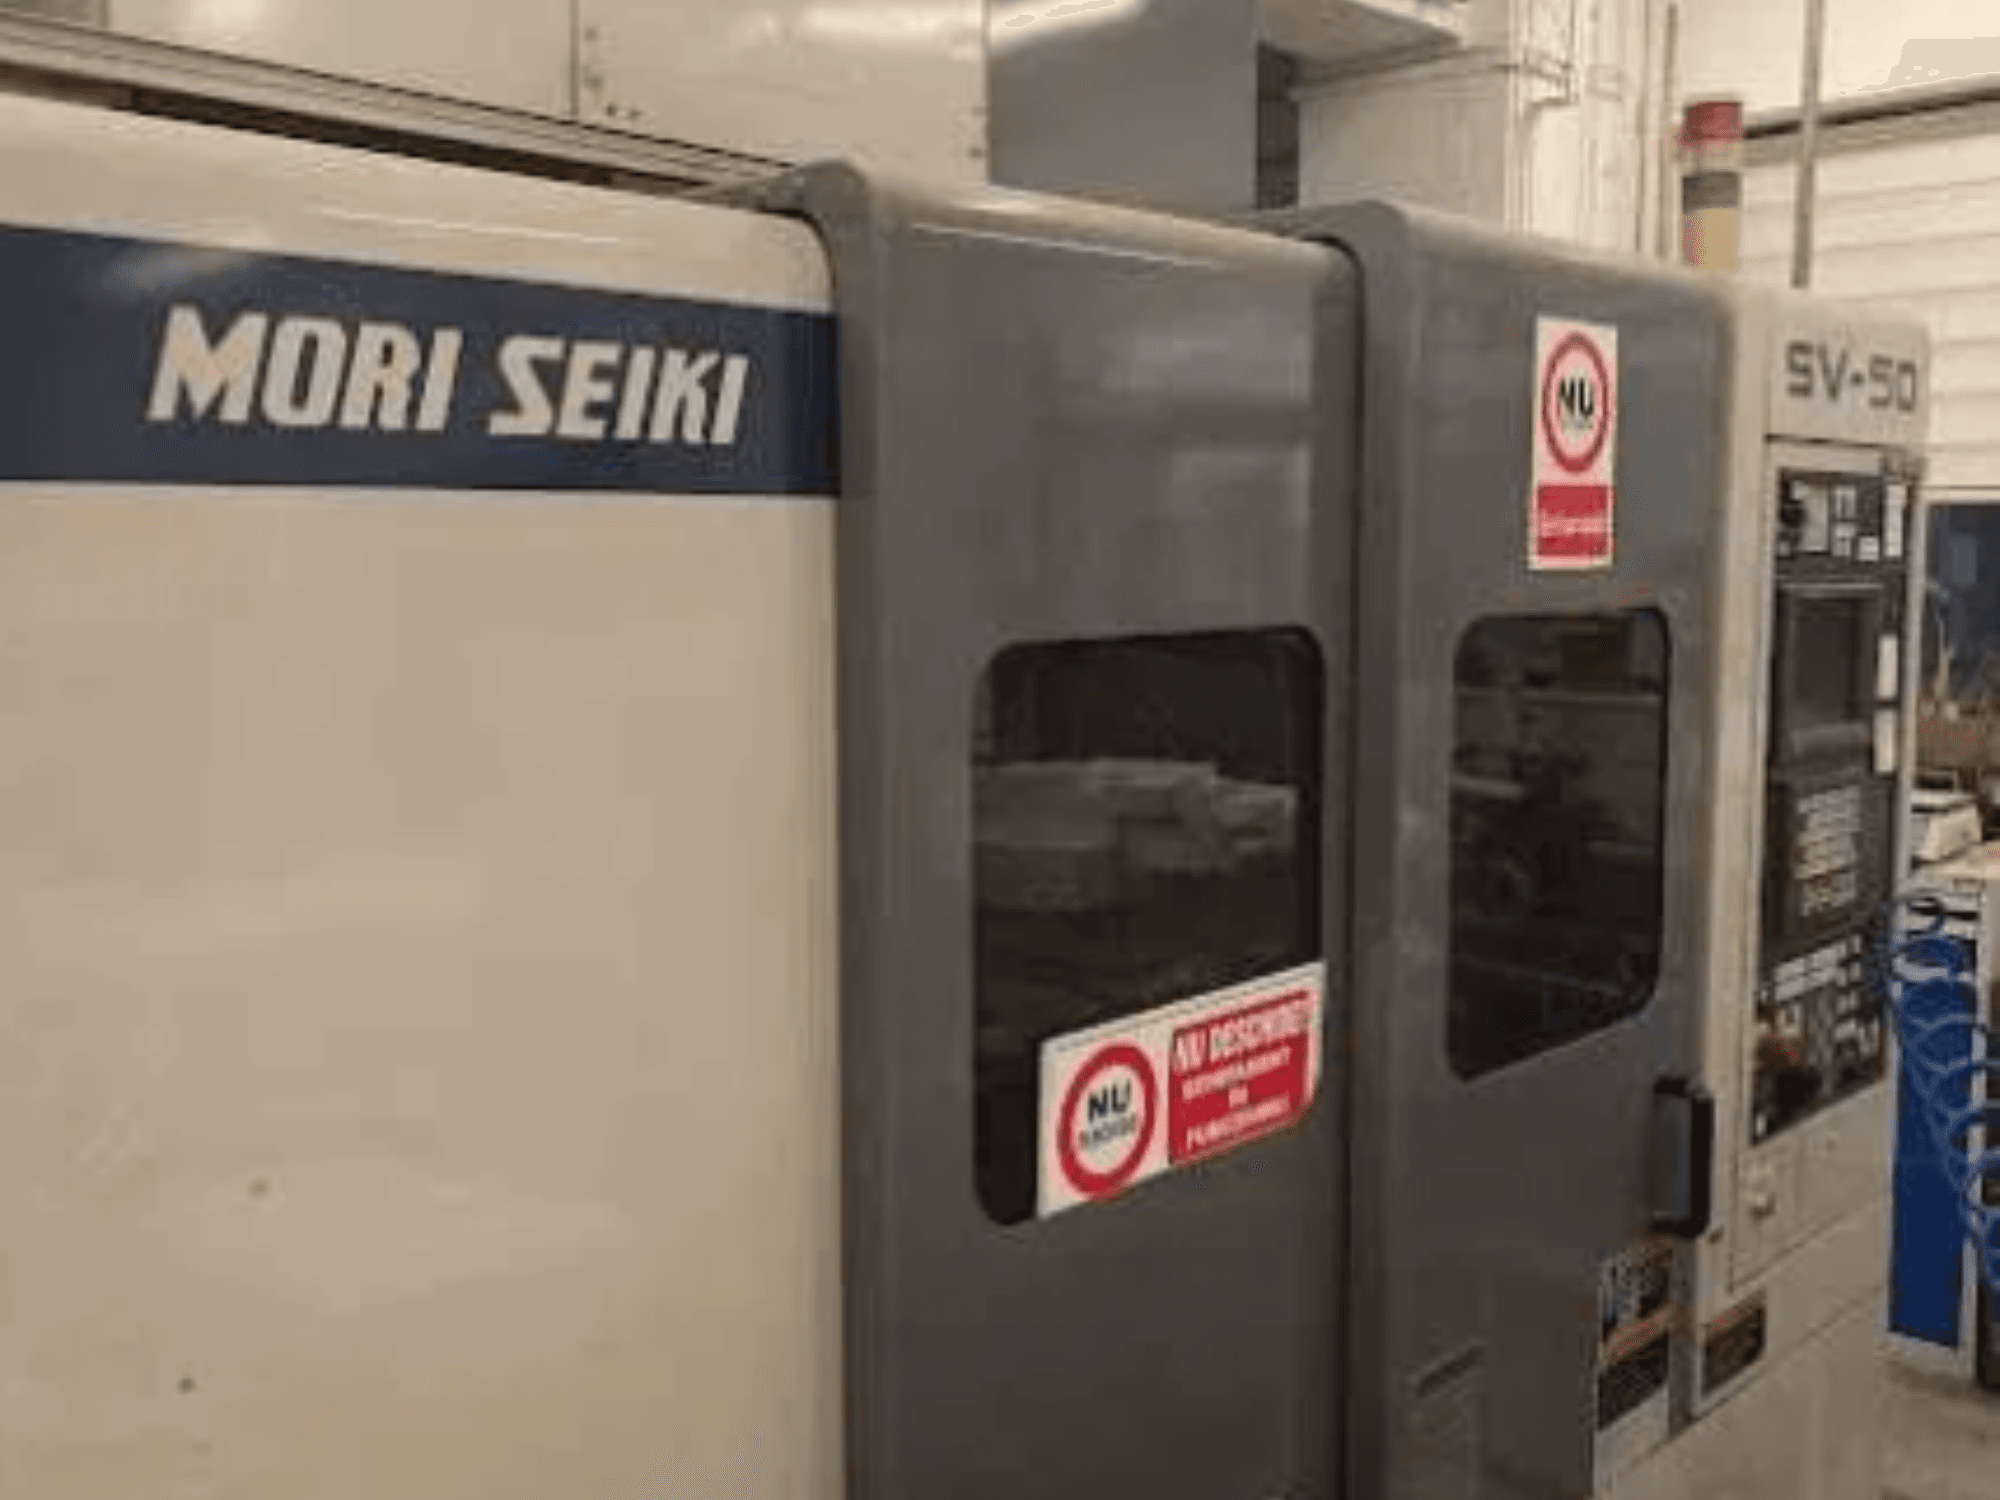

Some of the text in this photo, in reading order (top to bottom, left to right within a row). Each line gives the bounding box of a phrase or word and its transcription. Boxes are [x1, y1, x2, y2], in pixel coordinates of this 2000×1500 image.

[146, 303, 750, 446] MORI SEIKI
[1559, 376, 1595, 416] NU
[1786, 339, 1916, 412] SV-50
[1087, 1078, 1132, 1125] NU
